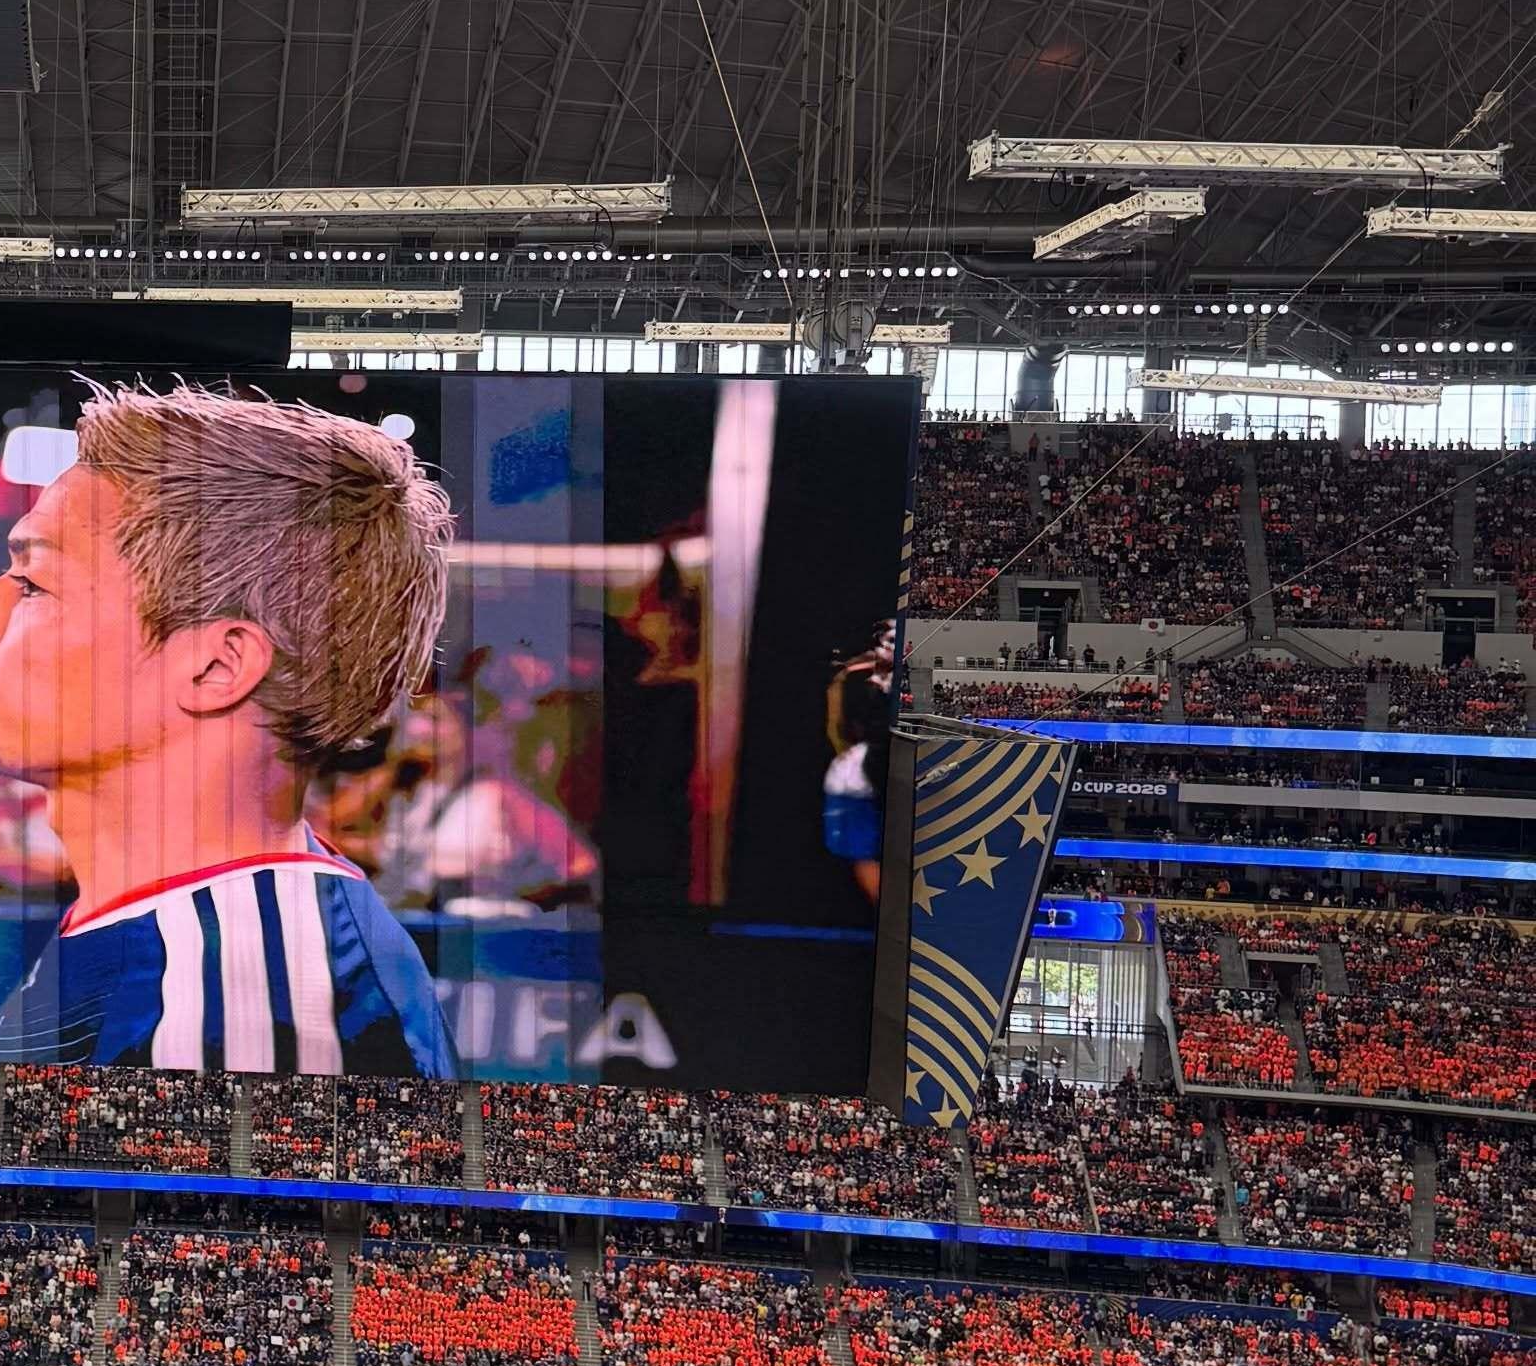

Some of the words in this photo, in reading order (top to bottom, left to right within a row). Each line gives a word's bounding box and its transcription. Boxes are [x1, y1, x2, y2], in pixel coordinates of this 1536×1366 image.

[1084, 782, 1113, 793] CUP
[1115, 783, 1167, 795] 2026
[436, 978, 678, 1069] IFA
